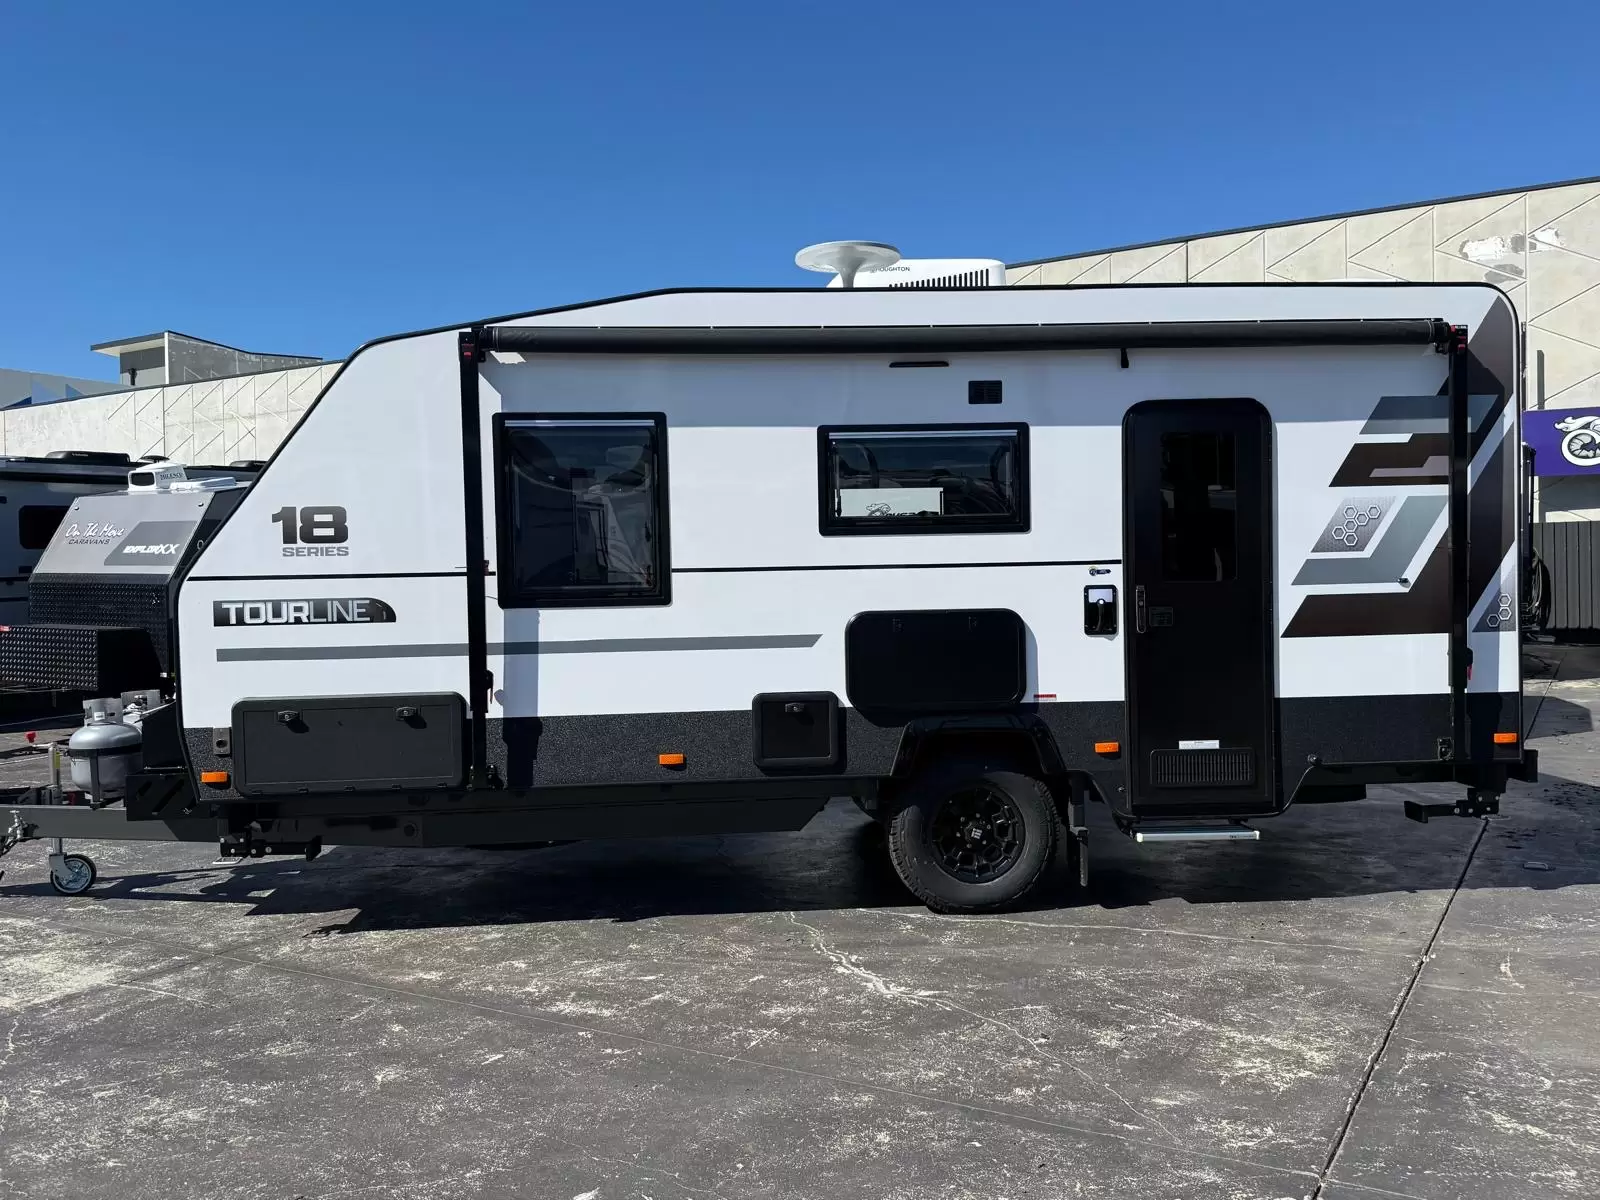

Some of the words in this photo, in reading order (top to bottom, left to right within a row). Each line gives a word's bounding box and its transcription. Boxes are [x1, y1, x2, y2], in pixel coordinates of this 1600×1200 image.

[66, 523, 81, 538] On
[84, 522, 98, 538] The
[99, 521, 125, 538] Move
[271, 505, 349, 545] 18
[282, 546, 349, 557] SERIES
[221, 599, 371, 625] TOURLINE
